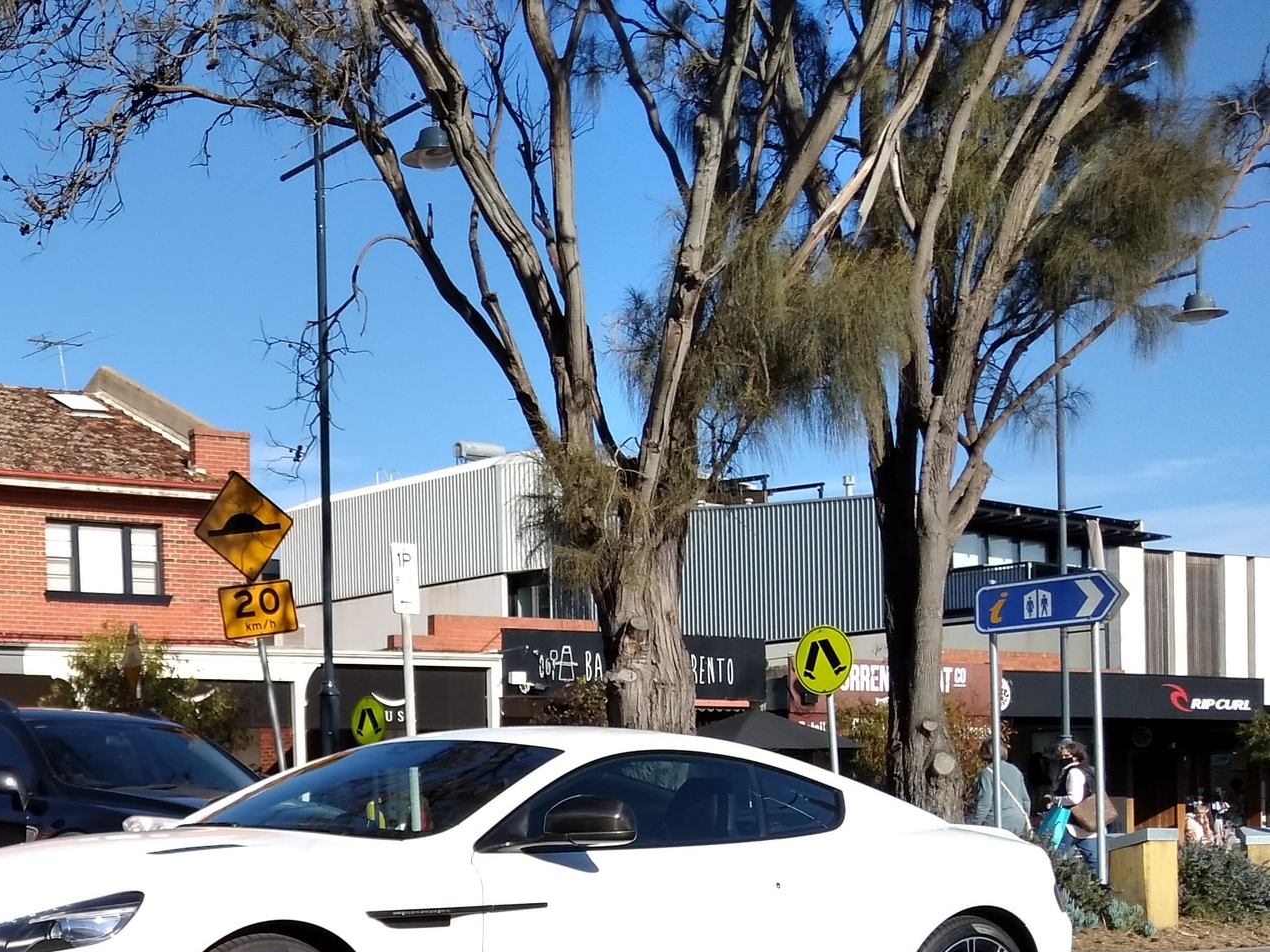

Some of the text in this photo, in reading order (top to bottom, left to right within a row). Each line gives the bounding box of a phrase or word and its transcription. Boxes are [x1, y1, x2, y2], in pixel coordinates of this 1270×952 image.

[396, 552, 412, 568] 1P
[233, 587, 280, 619] 20
[245, 619, 277, 632] km/h
